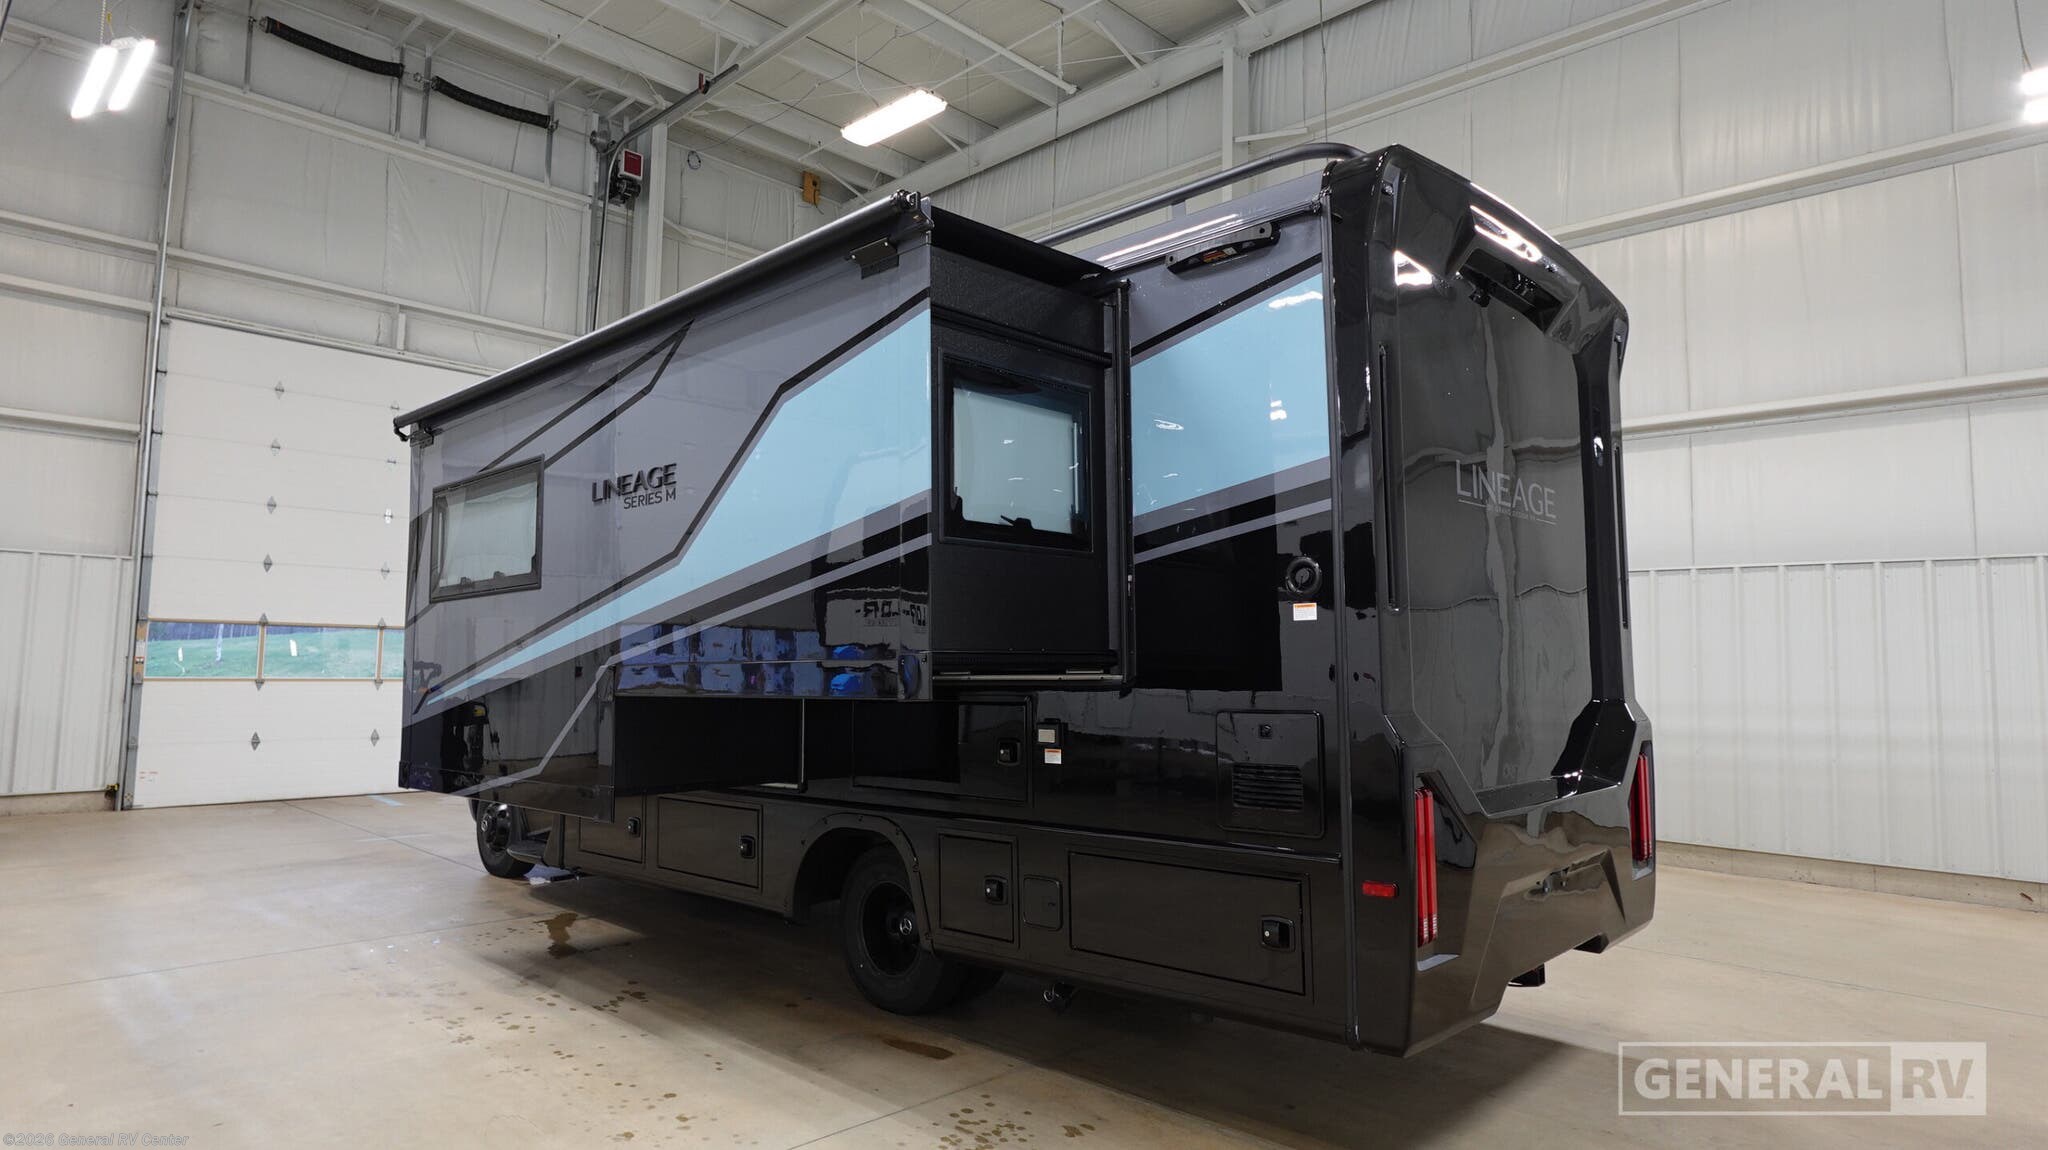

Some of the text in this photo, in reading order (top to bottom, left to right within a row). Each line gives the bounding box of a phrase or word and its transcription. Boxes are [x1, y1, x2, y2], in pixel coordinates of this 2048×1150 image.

[591, 462, 677, 503] LINEAGE
[623, 487, 676, 510] SERIES M
[1456, 459, 1557, 519] LINEAGE
